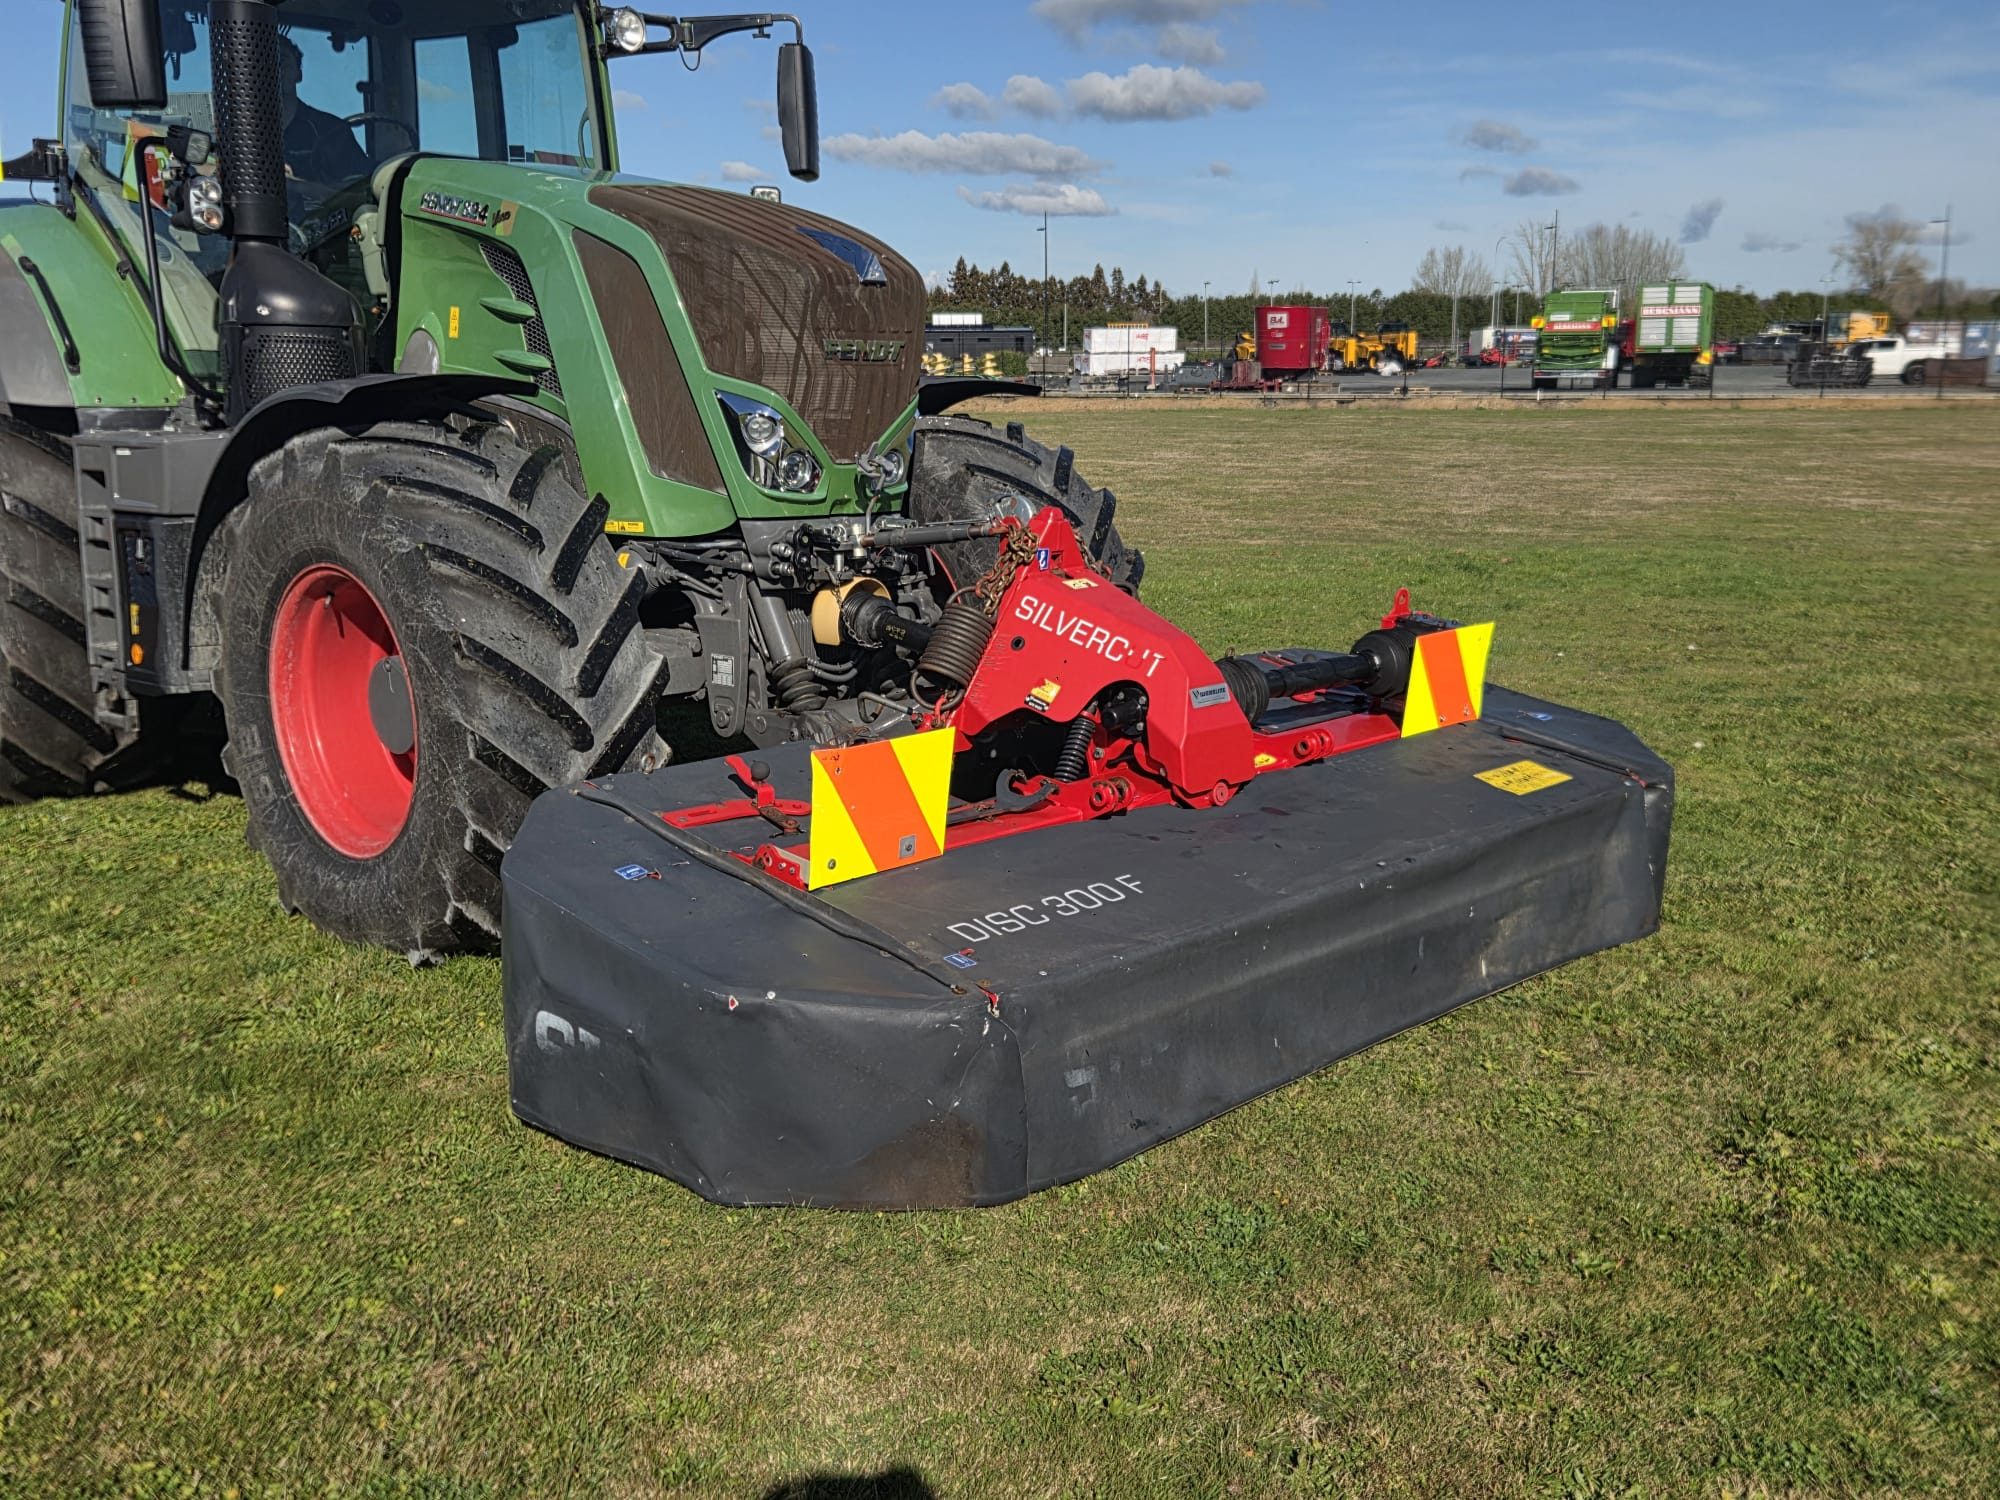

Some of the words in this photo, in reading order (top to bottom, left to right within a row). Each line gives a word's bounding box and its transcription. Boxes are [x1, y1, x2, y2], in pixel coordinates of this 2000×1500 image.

[822, 338, 905, 362] FENDT
[946, 904, 1050, 942] DISC
[1041, 876, 1126, 916] 300
[1114, 874, 1144, 894] F
